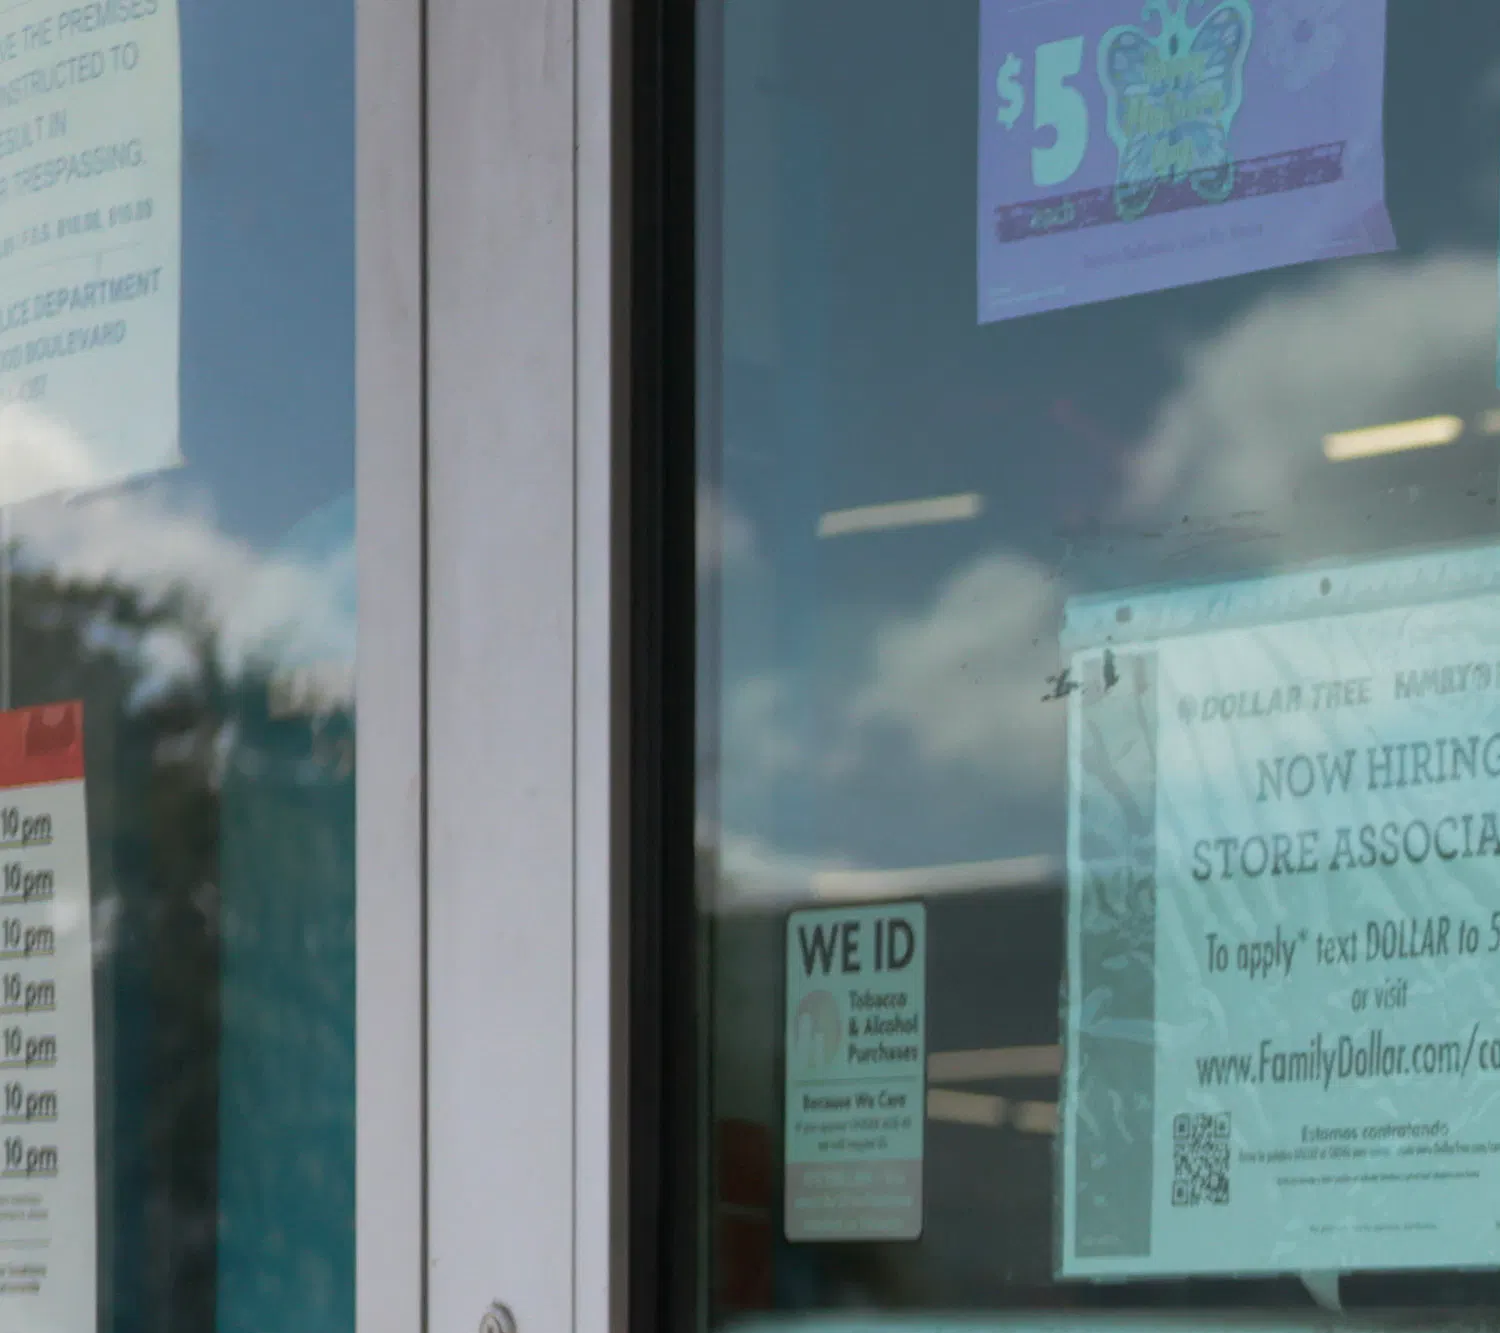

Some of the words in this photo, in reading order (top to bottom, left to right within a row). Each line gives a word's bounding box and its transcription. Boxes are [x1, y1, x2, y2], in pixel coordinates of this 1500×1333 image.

[109, 41, 139, 73] TO
[997, 36, 1088, 187] $5
[1200, 690, 1303, 723] DOLLAR
[1311, 676, 1373, 709] TREE
[1256, 746, 1357, 803] NOW
[22, 811, 52, 841] pm
[1191, 828, 1320, 881] STORE
[23, 867, 54, 897] pm
[25, 921, 55, 952] pm
[798, 919, 861, 977] WE
[874, 917, 916, 973] ID
[1206, 934, 1229, 973] To
[1316, 930, 1357, 964] text
[1366, 914, 1450, 962] DOLLAR
[1459, 918, 1479, 955] to
[25, 977, 55, 1009] pm
[1351, 984, 1370, 1012] or
[1374, 977, 1408, 1009] visit
[864, 1013, 918, 1035] Alcohol
[26, 1032, 56, 1064] pm
[27, 1087, 57, 1118] pm
[27, 1142, 58, 1173] pm
